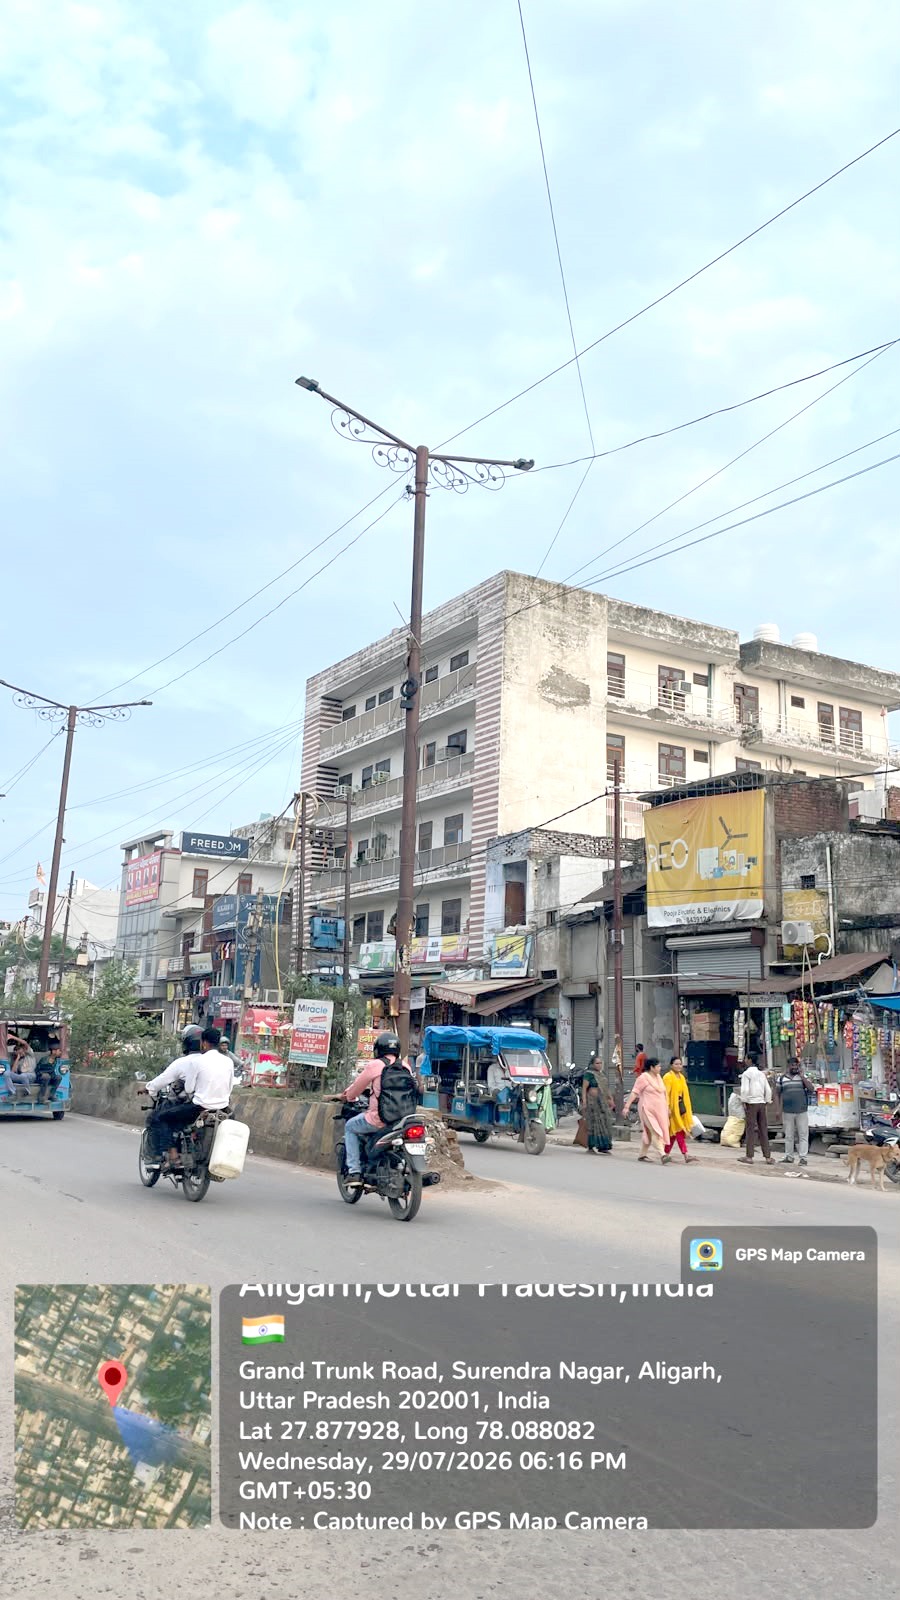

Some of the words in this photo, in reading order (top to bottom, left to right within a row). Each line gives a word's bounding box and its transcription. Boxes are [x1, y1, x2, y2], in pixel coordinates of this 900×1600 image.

[297, 1004, 328, 1014] Miracle
[295, 1031, 326, 1040] CHEMISTRY
[303, 1042, 326, 1050] SUBJECT
